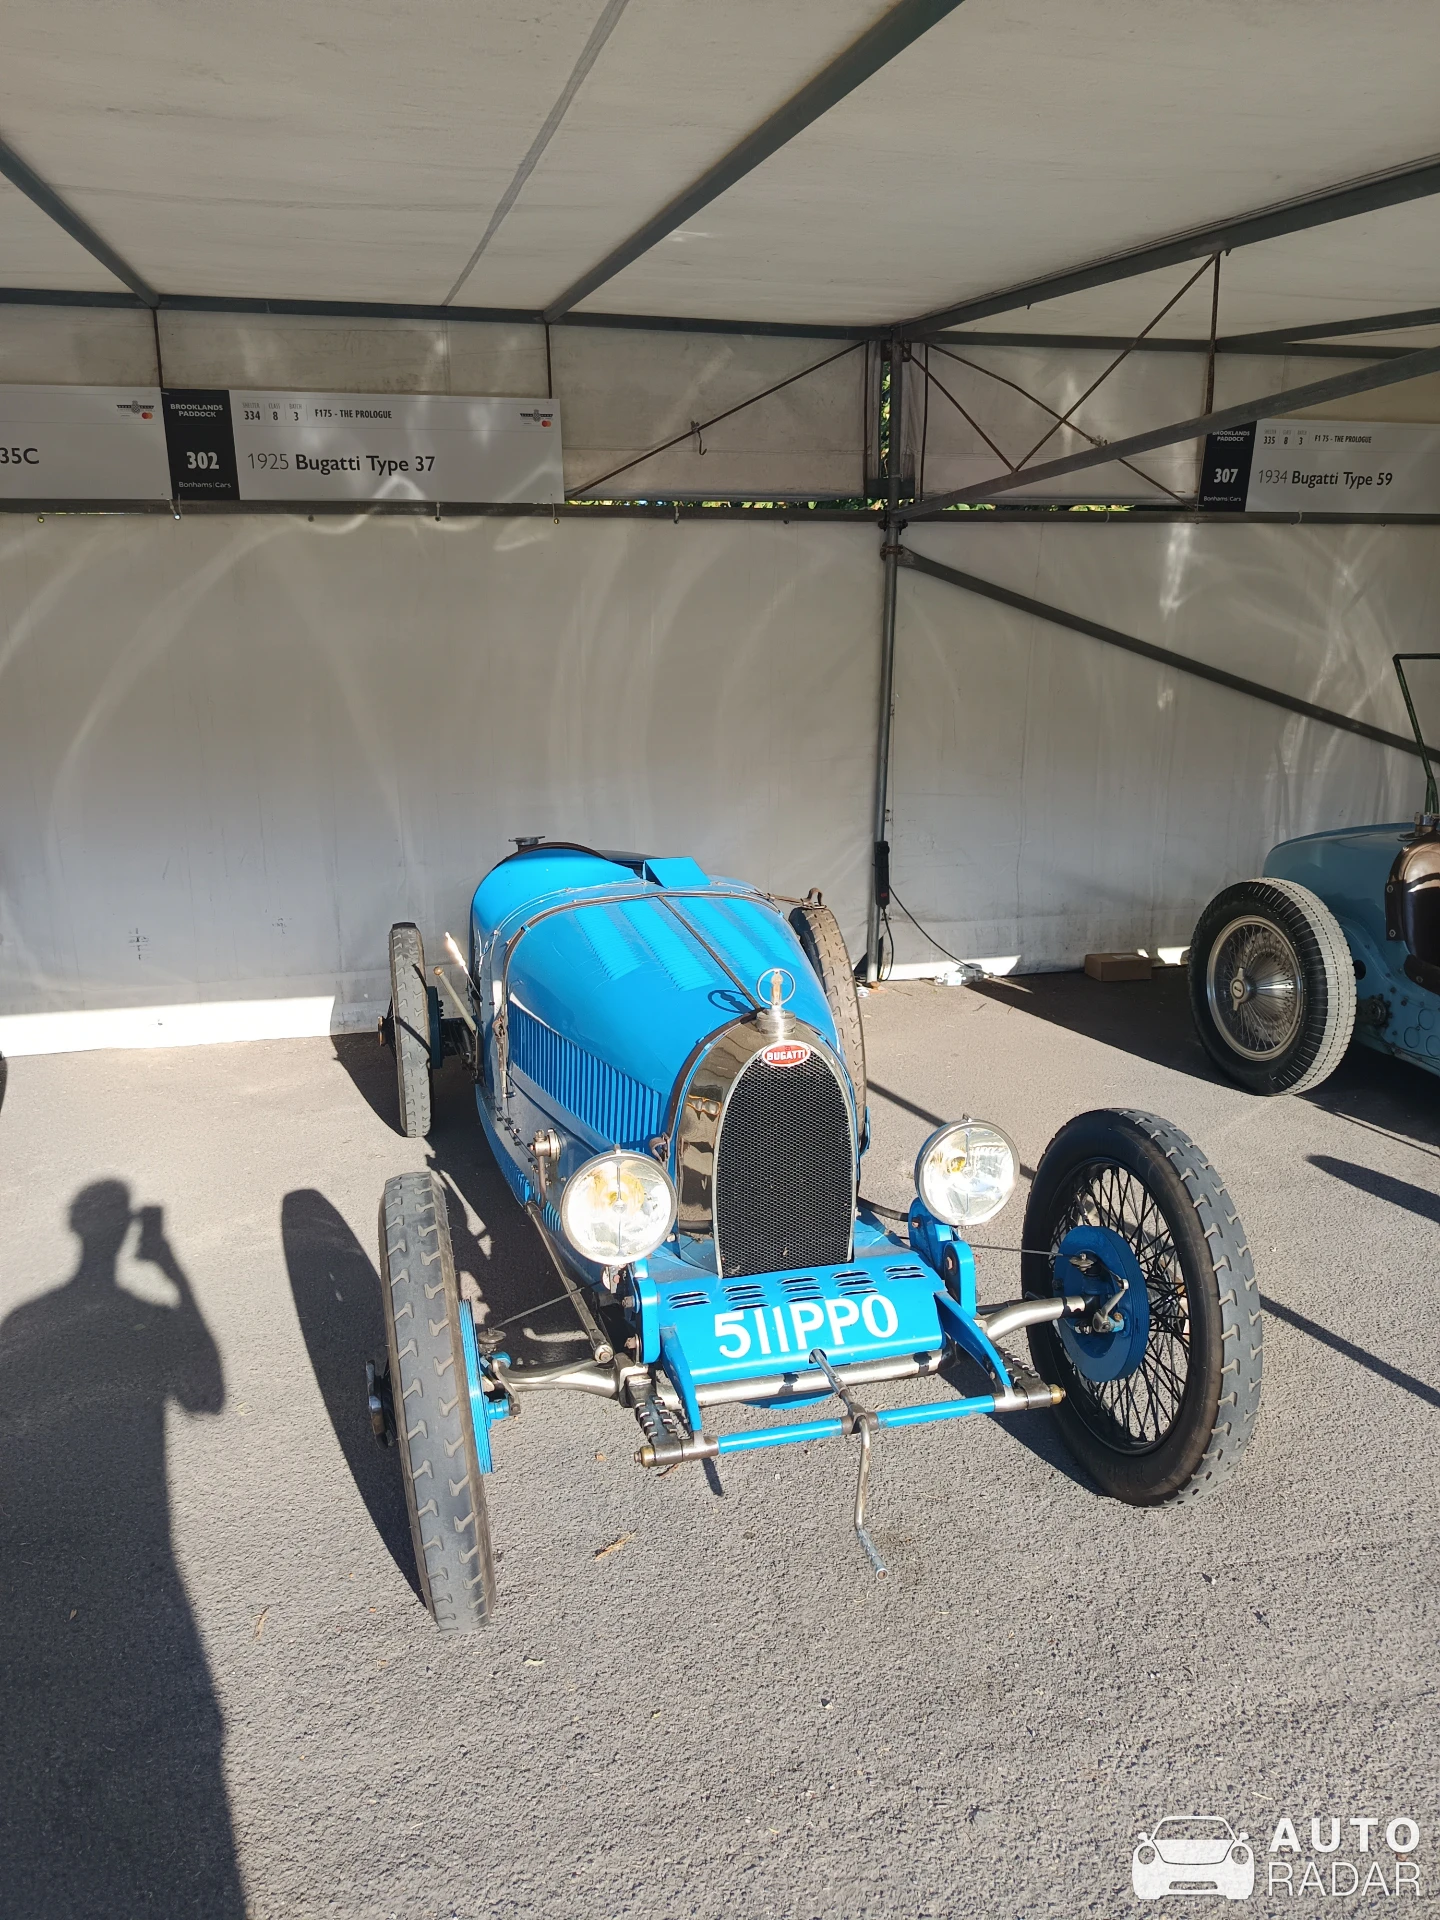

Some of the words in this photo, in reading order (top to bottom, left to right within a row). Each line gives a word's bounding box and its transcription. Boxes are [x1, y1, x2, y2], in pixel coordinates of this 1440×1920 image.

[170, 403, 223, 411] BROOKLANDS
[244, 410, 261, 420] 334
[272, 411, 279, 421] 8
[293, 411, 299, 421] 3
[340, 409, 354, 418] THE
[355, 410, 392, 419] PROLOGUE
[1263, 436, 1276, 445] 335
[1298, 437, 1303, 445] 3
[1334, 435, 1345, 443] THE
[1345, 435, 1372, 443] PROLOGUE
[0, 447, 40, 465] 35C
[186, 451, 220, 470] 302
[247, 453, 289, 470] 1925
[295, 454, 360, 475] Bugatti
[366, 455, 409, 476] Type
[415, 456, 435, 471] 37
[1213, 468, 1239, 483] 307
[1258, 470, 1288, 484] 1934
[1291, 470, 1338, 488] Bugatti
[1343, 472, 1373, 489] Type
[1376, 472, 1393, 486] 59
[766, 1049, 806, 1061] BUGATTI
